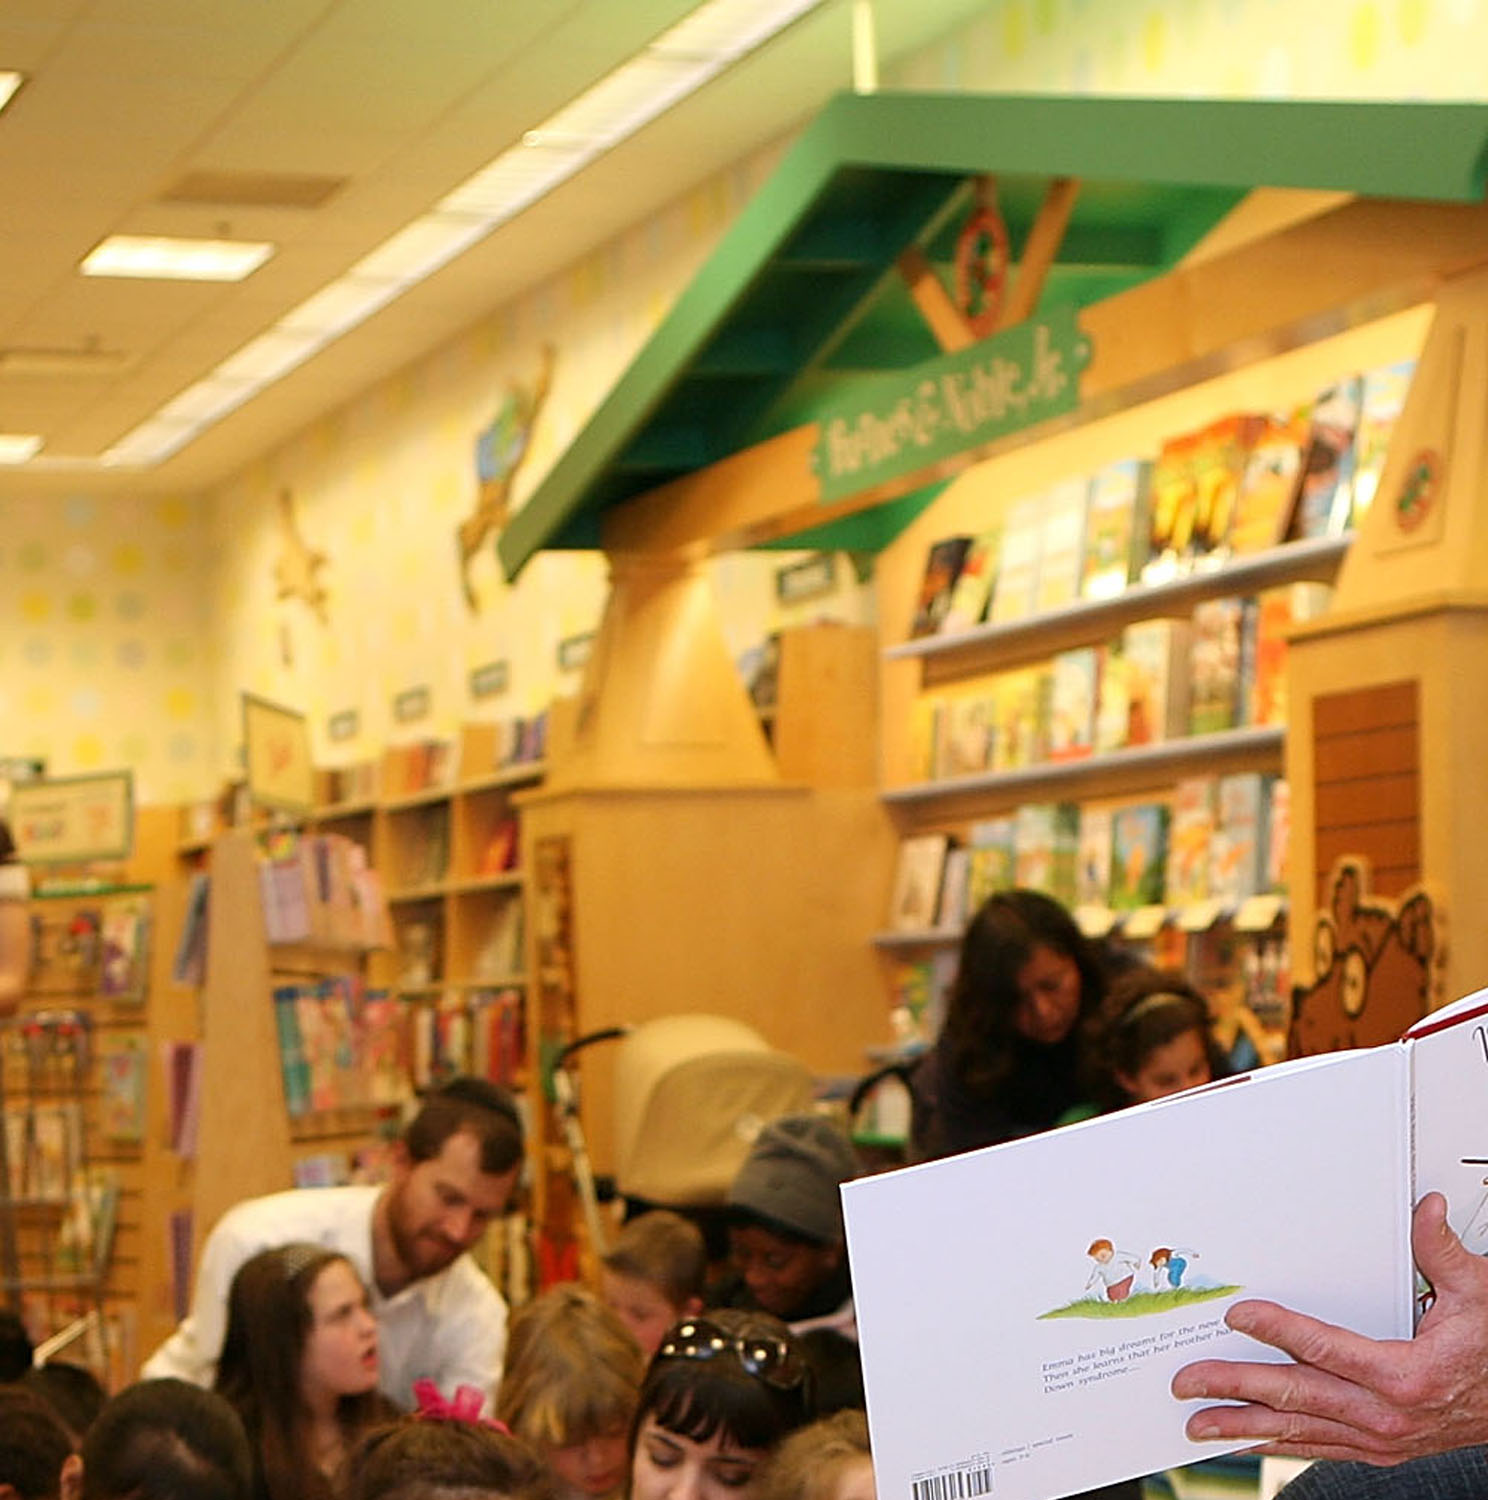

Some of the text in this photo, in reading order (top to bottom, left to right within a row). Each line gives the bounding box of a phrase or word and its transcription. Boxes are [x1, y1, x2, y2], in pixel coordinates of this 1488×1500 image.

[1042, 1358, 1074, 1371] Emma
[1099, 1346, 1115, 1358] big
[1118, 1336, 1156, 1353] dreams
[1160, 1331, 1174, 1342] for
[1178, 1325, 1195, 1336] the
[1092, 1356, 1125, 1370] learns
[1153, 1343, 1171, 1355] her
[1173, 1333, 1212, 1350] brother
[1044, 1381, 1074, 1394] Down
